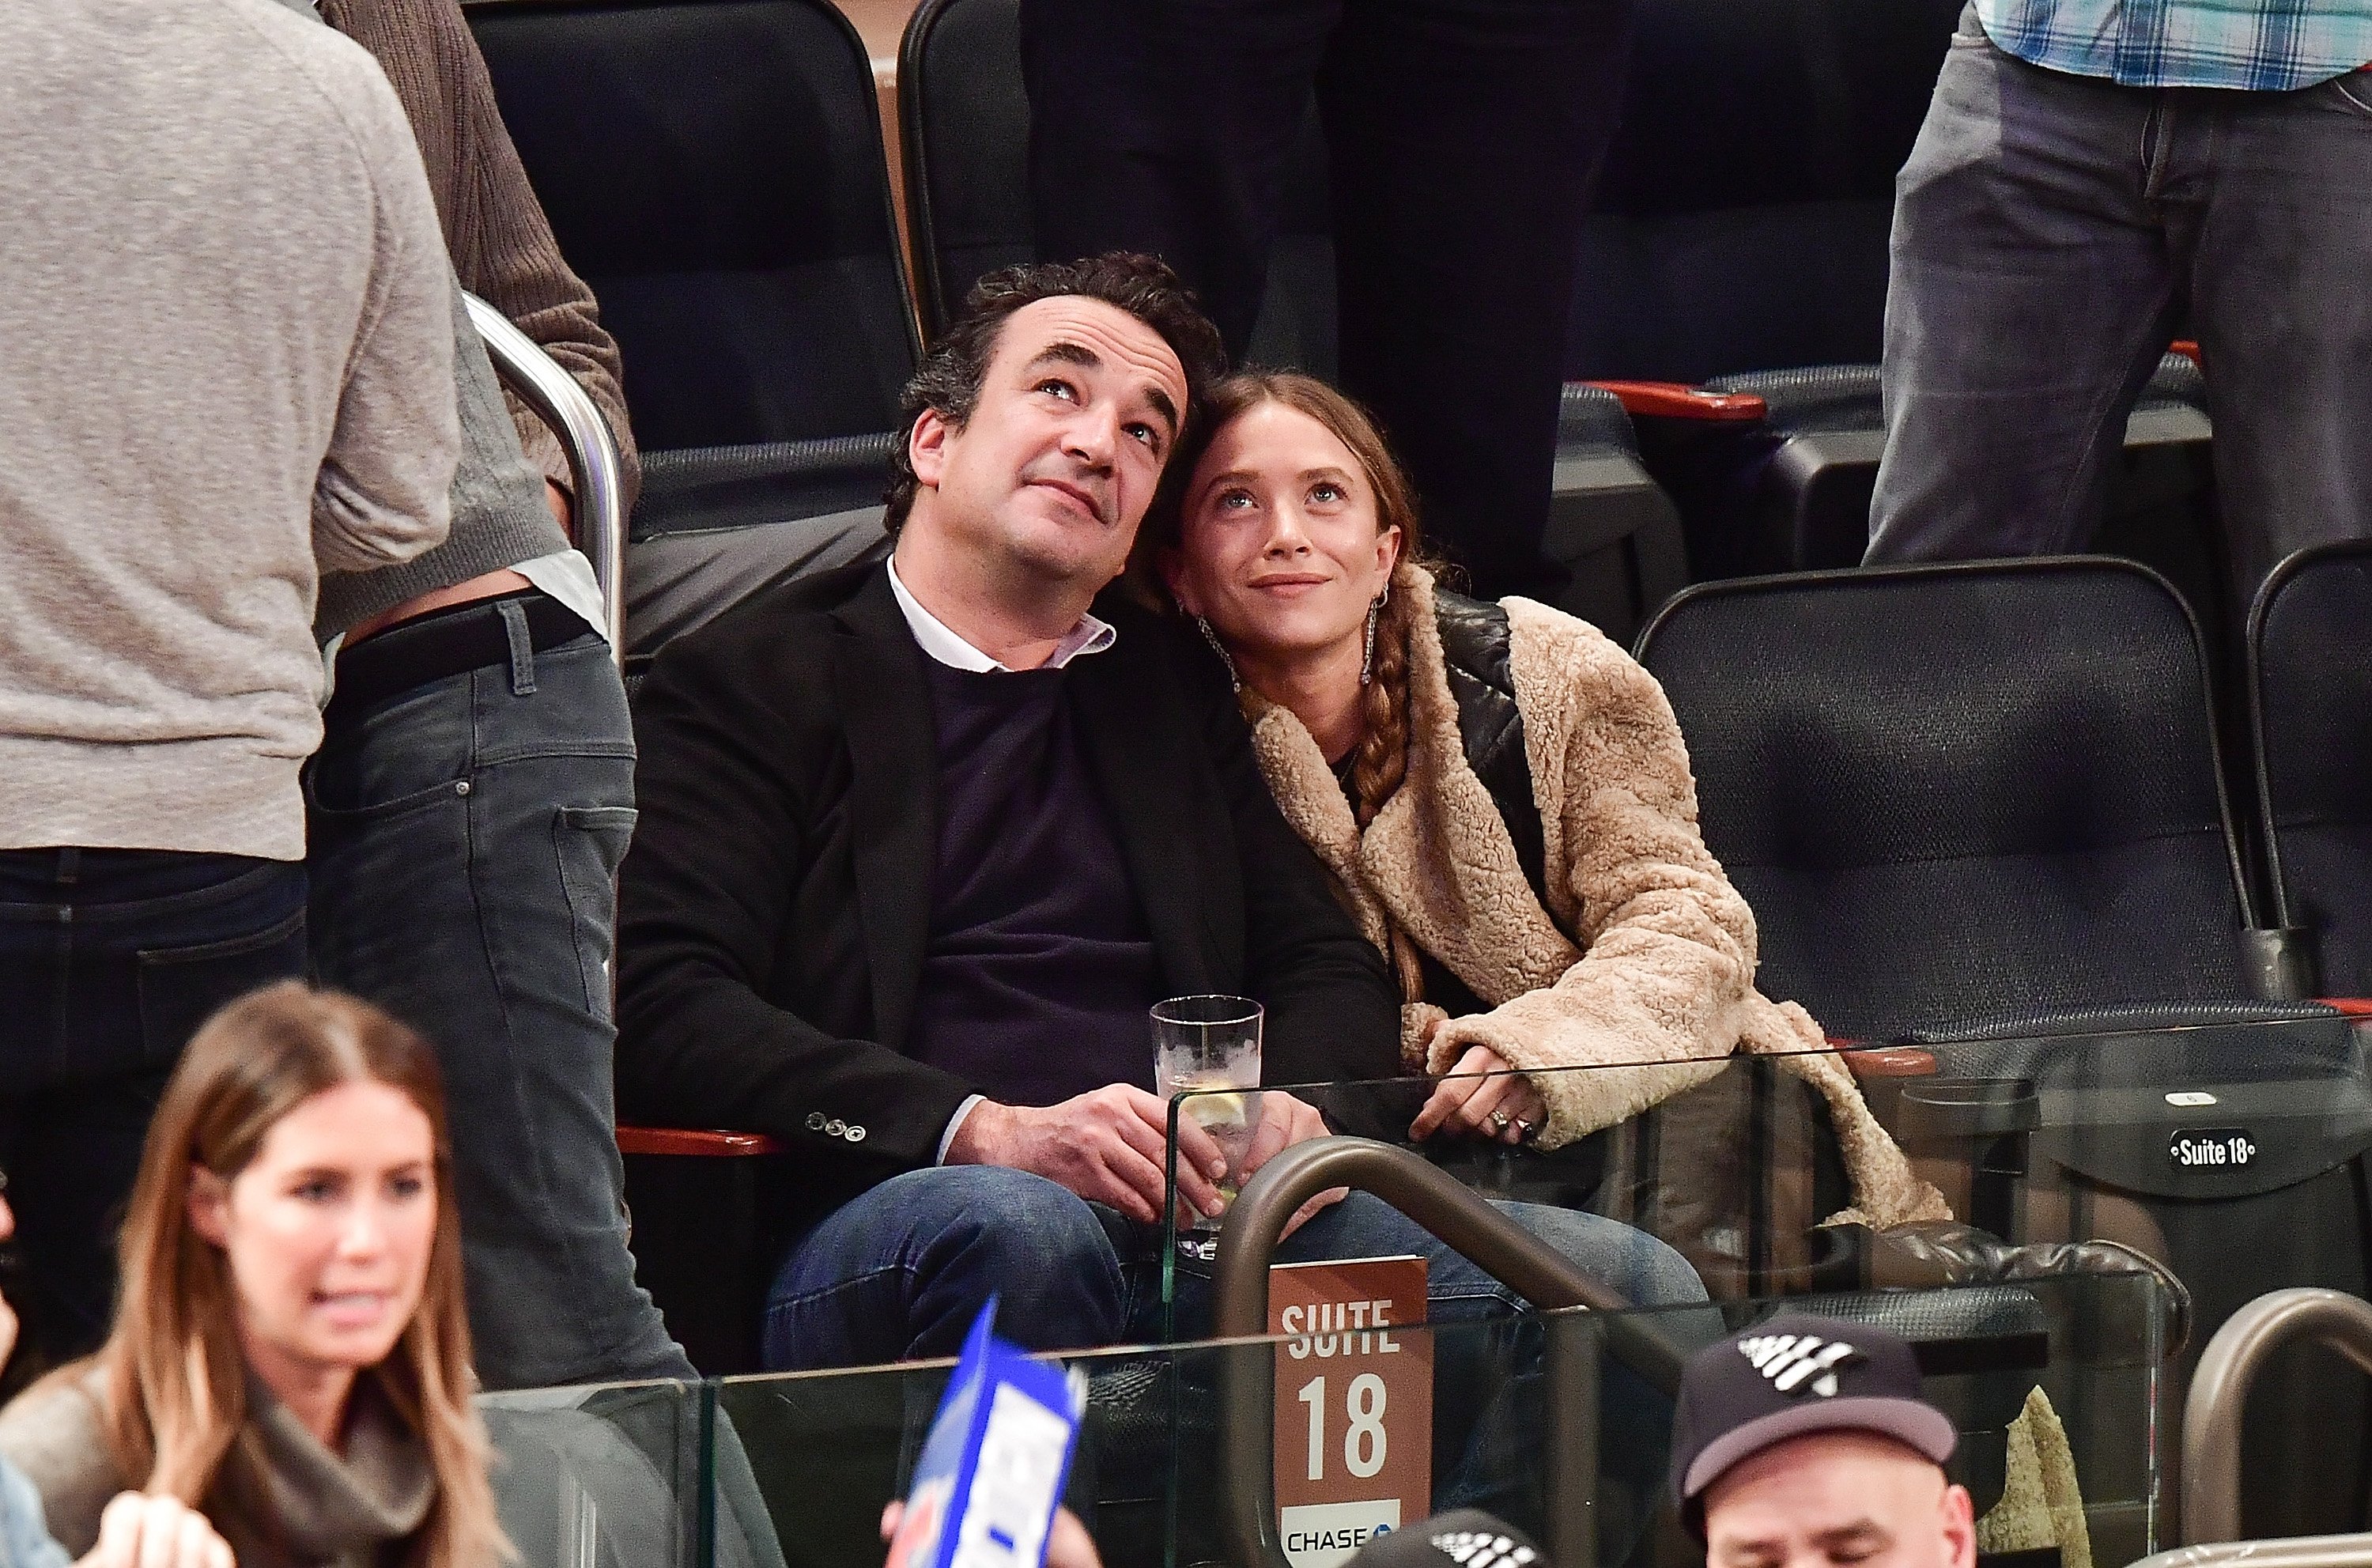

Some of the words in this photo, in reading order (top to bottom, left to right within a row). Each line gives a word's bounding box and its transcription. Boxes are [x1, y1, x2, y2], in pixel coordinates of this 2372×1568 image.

[2180, 1139, 2226, 1166] Suite
[2227, 1137, 2248, 1164] 18
[1282, 1299, 1400, 1359] SUITE
[1298, 1373, 1387, 1480] 18
[1288, 1528, 1367, 1552] CHASE
